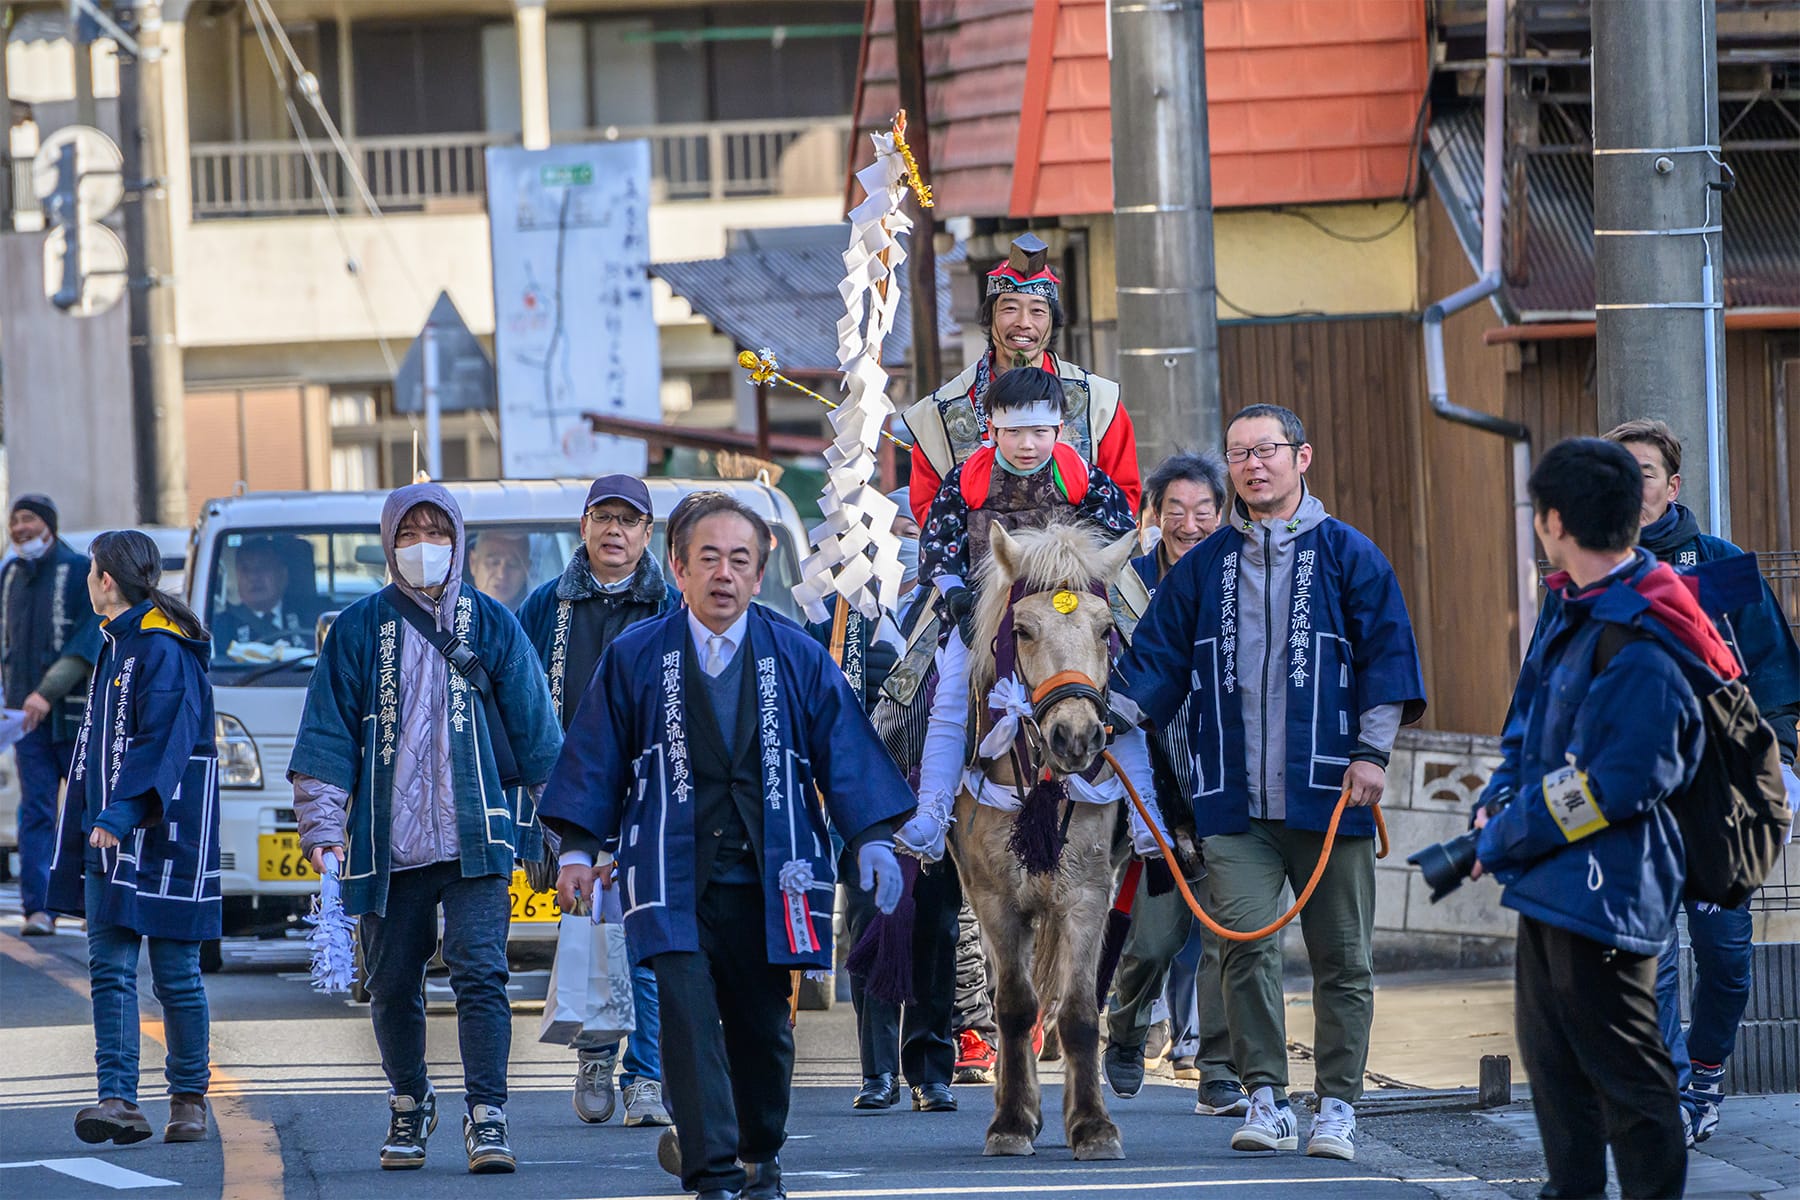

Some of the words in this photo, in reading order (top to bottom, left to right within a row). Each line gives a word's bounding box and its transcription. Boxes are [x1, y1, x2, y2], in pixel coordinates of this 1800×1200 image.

[449, 596, 472, 732] 明覺三鏑馬會
[1220, 551, 1238, 694] 明覺三氏流鏑馬會
[1288, 550, 1316, 688] 明覺三氏流鏑馬會
[378, 620, 398, 766] 明覺三氏流鏑馬會
[663, 650, 694, 804] 明覺三氏流鏑馬會
[758, 656, 784, 810] 明覺三氏流鏑馬會
